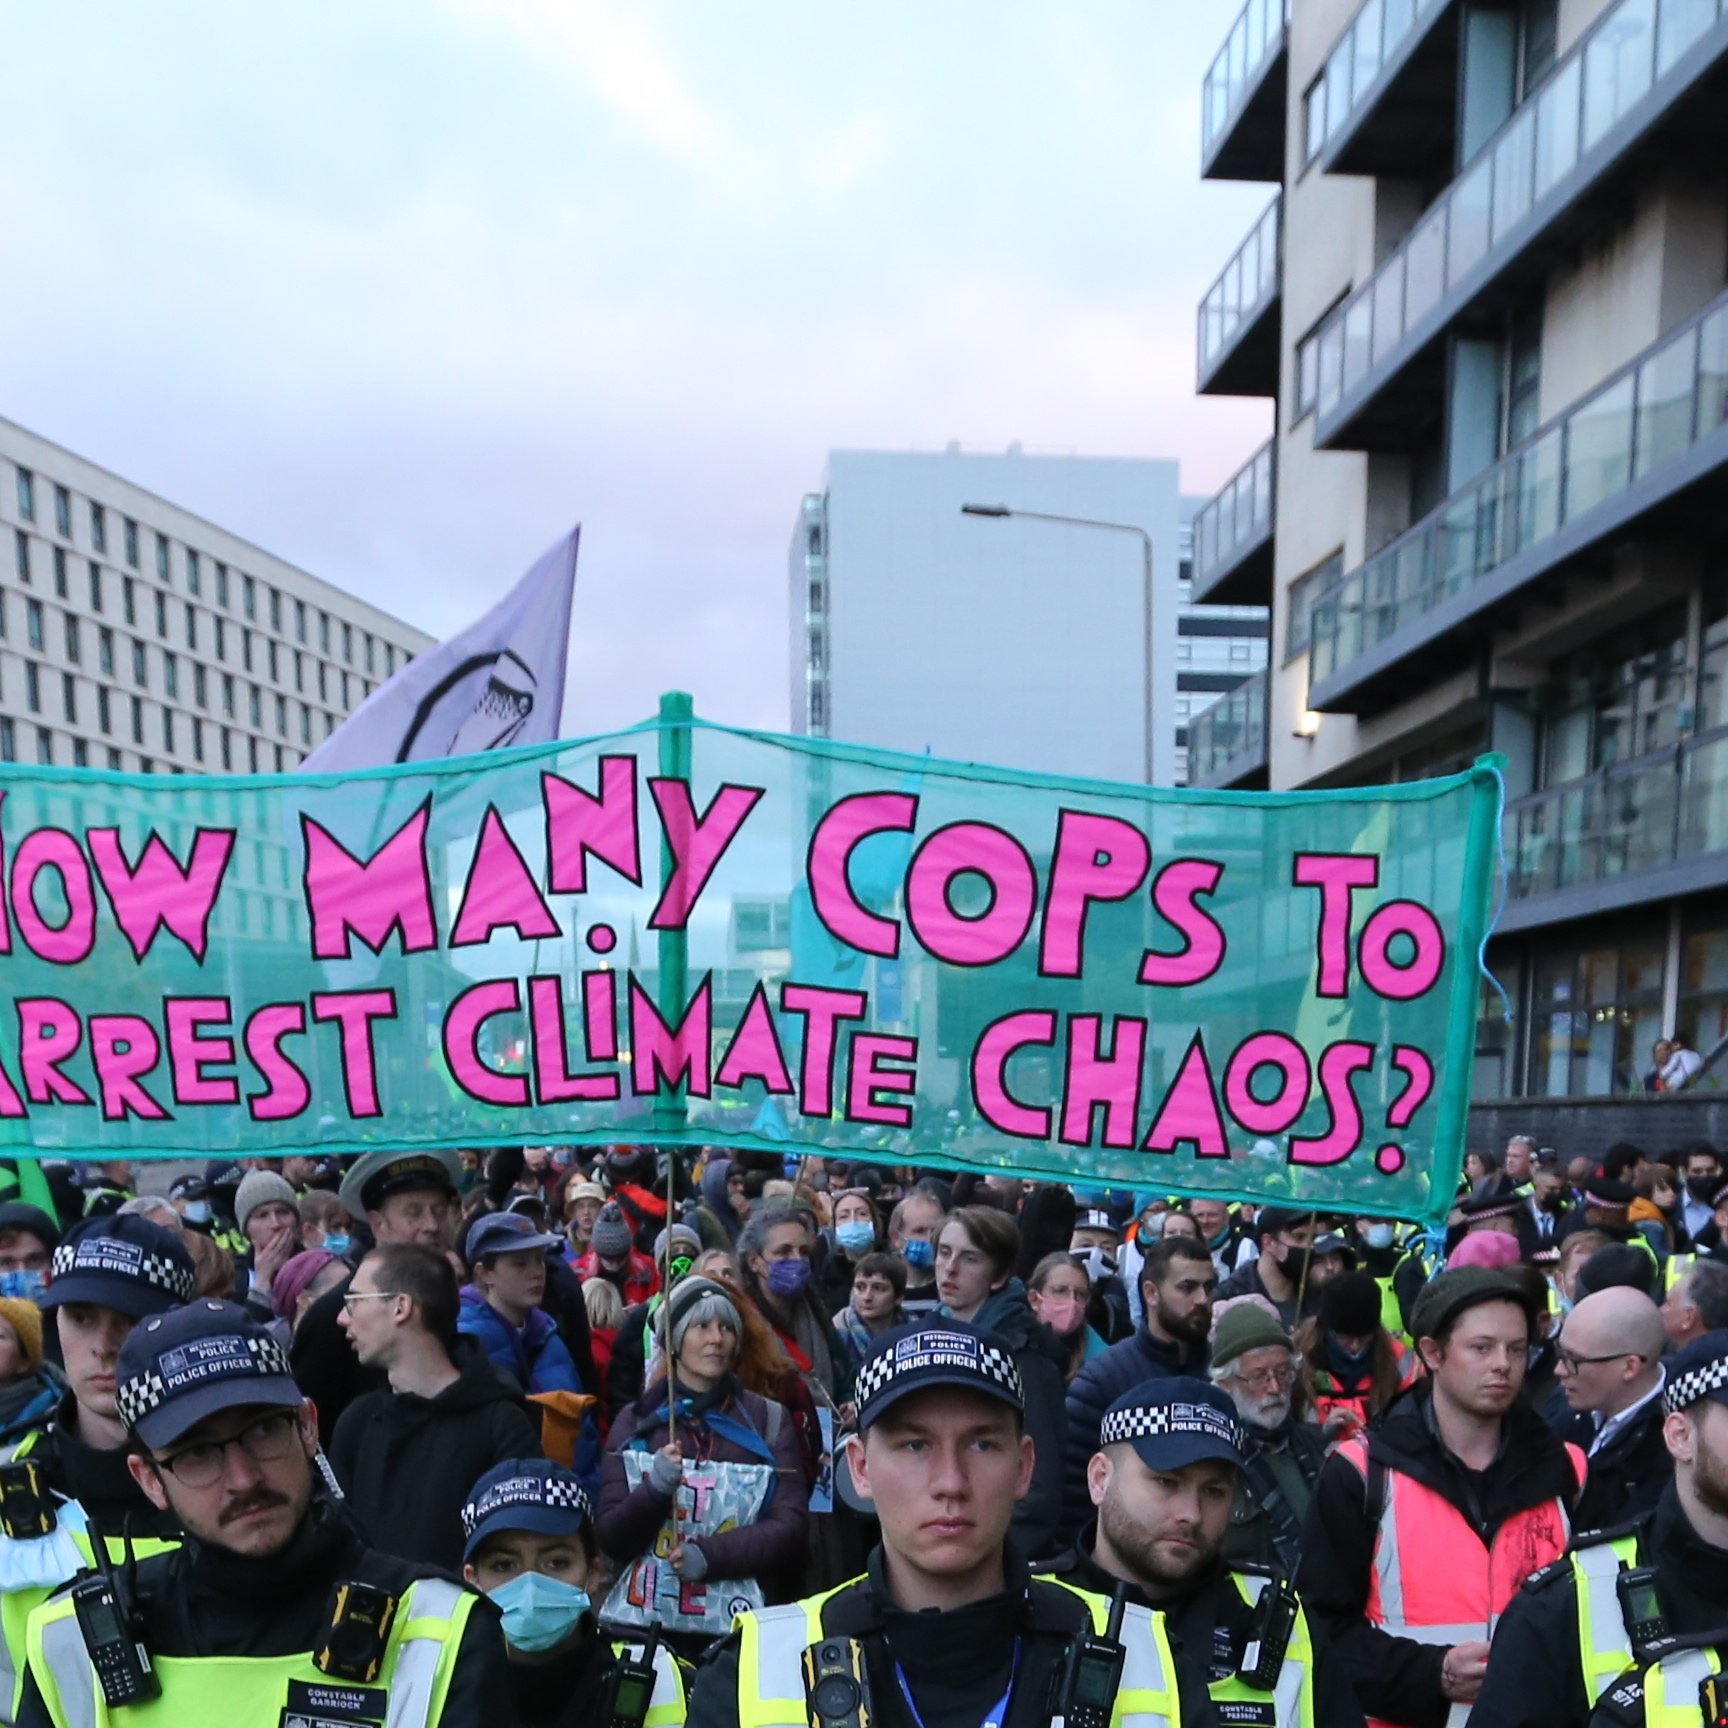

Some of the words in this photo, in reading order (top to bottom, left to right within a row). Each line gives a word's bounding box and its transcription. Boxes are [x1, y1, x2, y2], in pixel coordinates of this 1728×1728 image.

[299, 753, 767, 960] MANY
[807, 790, 1227, 988] COPS
[970, 1008, 1436, 1176] CHAOS?
[74, 1256, 101, 1269] POLICE
[101, 1257, 140, 1277] OFFICER
[198, 1344, 237, 1360] POLICE
[929, 1341, 966, 1350] POLICE
[167, 1363, 209, 1390] POLICE
[207, 1357, 253, 1374] OFFICER
[895, 1353, 932, 1375] POLICE
[932, 1352, 978, 1370] OFFICER
[1170, 1421, 1203, 1432] POLICE
[476, 1497, 503, 1517] POLICE
[502, 1491, 542, 1504] OFFICER
[306, 1687, 366, 1703] CONSTABLE
[1624, 1682, 1645, 1698] AS
